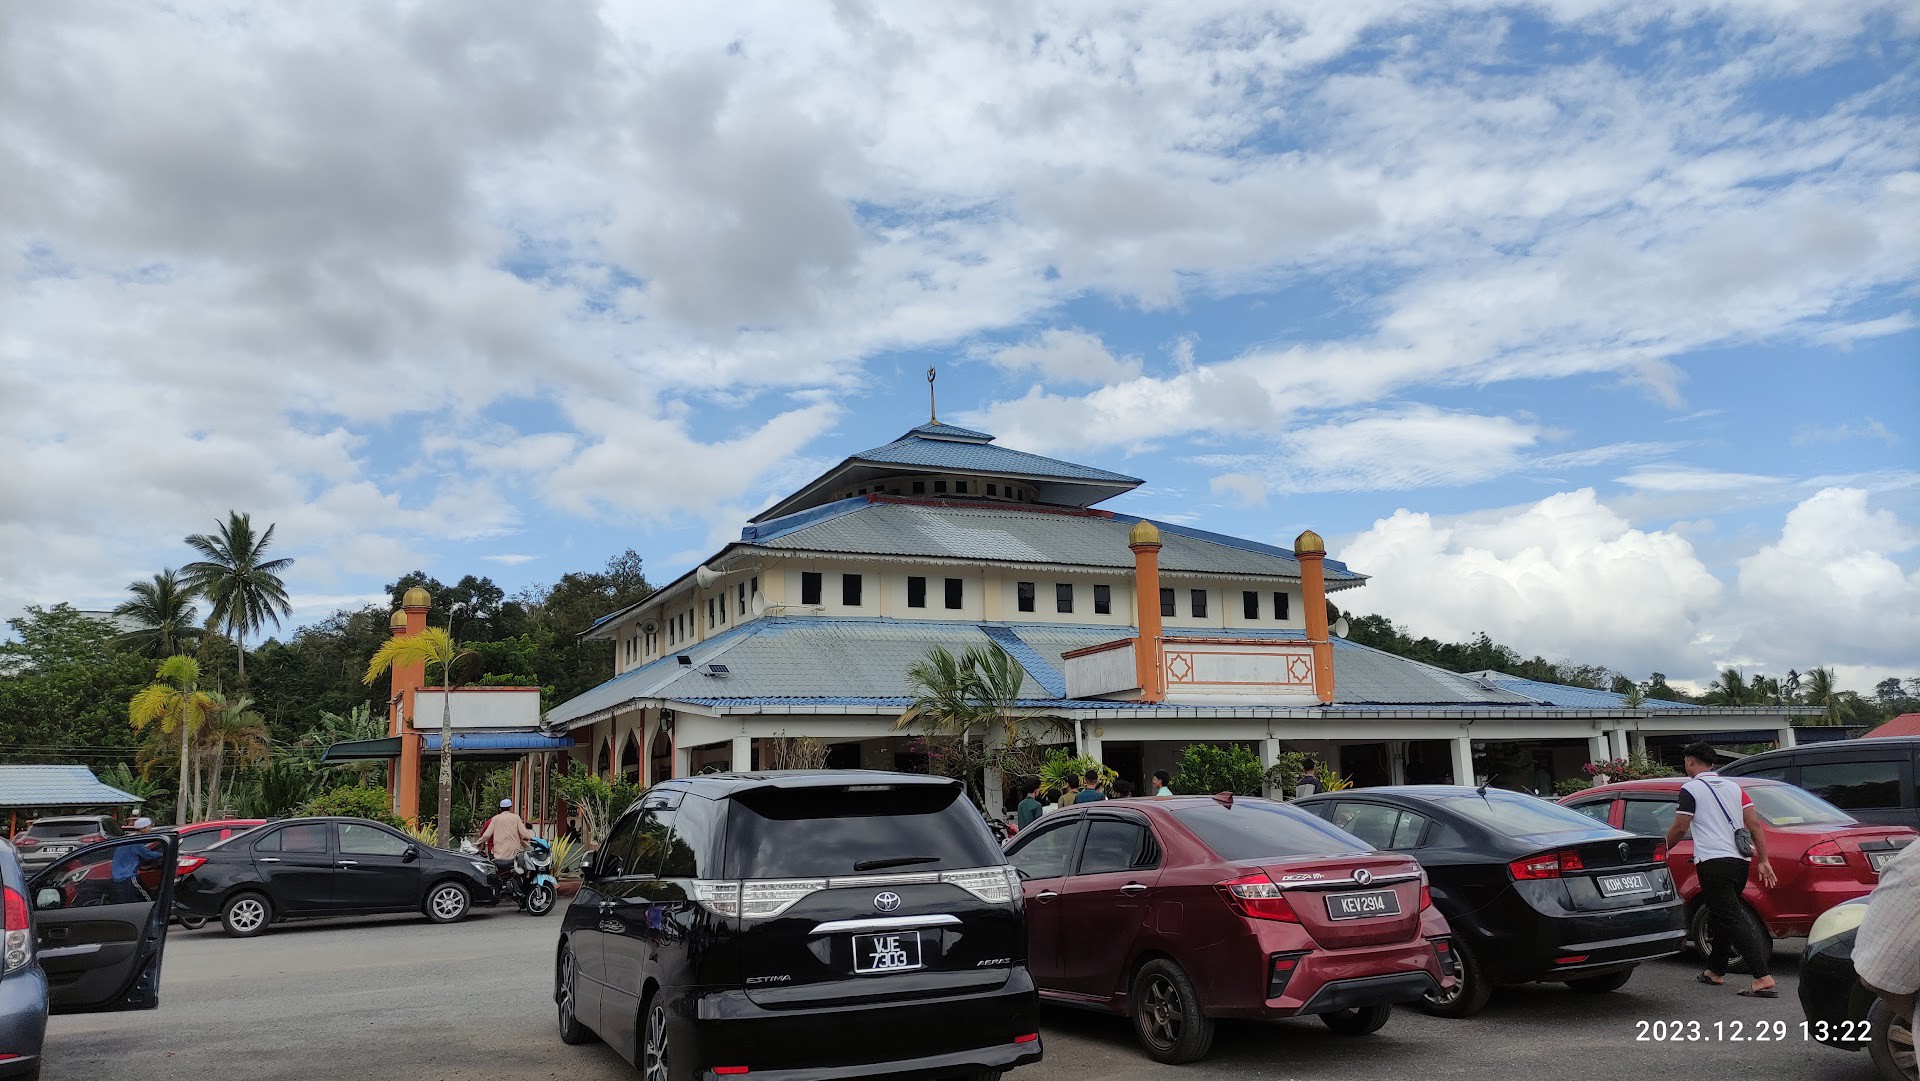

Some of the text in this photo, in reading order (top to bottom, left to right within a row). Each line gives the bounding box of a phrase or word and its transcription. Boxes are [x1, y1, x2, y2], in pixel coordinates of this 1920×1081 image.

[1604, 875, 1643, 892] KDH 9927
[873, 936, 900, 953] VJE
[869, 951, 907, 968] 7303
[746, 974, 791, 984] ESTIMA
